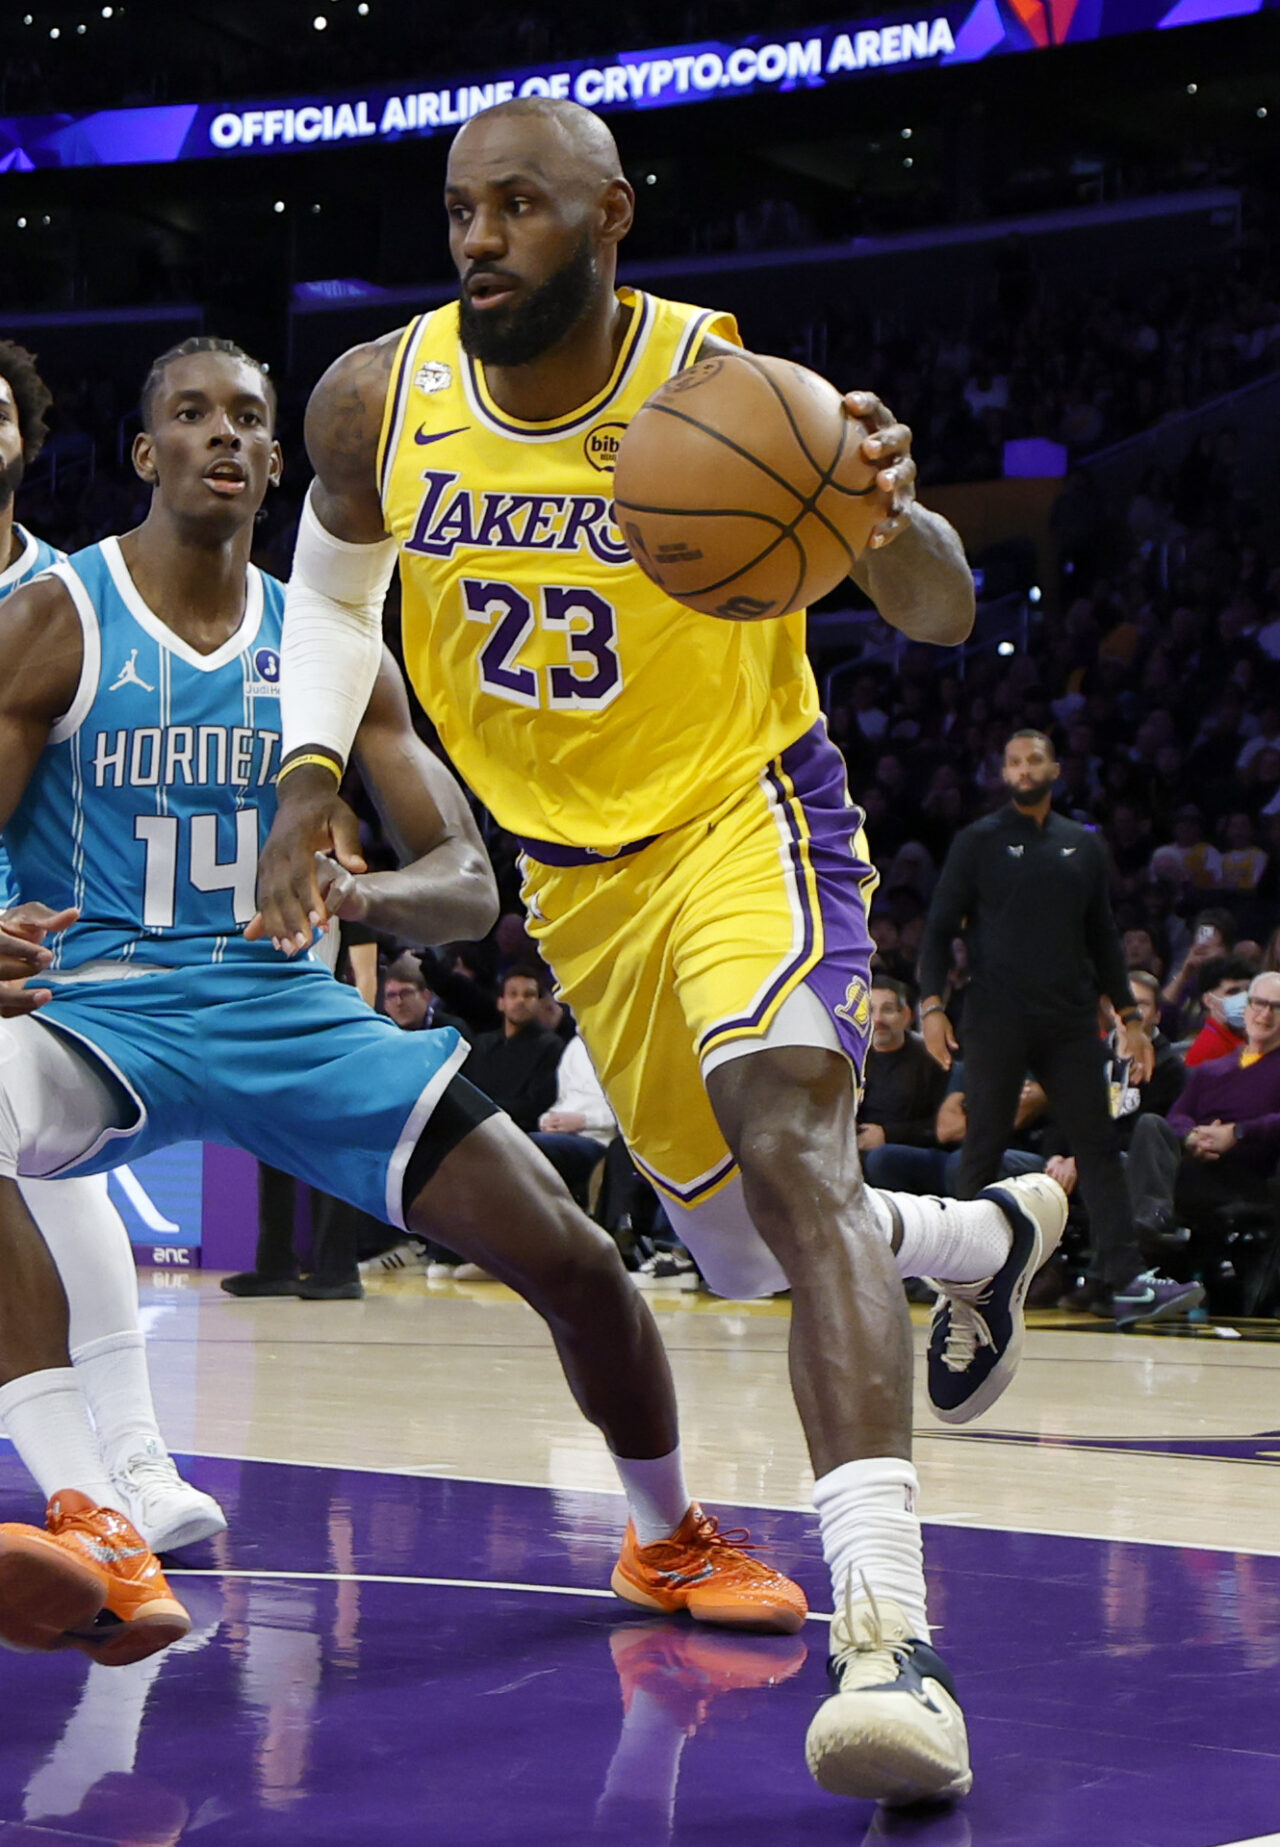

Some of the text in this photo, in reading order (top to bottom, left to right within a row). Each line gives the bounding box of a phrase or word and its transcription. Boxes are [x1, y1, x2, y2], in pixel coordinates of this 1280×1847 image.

[209, 101, 376, 148] OFFICIAL
[380, 80, 514, 133] AIRLINE
[574, 38, 822, 106] CRYPTO.COM
[826, 17, 955, 73] ARENA
[458, 577, 623, 711] 23
[92, 726, 280, 787] HORNET
[133, 808, 259, 928] 14
[153, 1246, 190, 1265] anc
